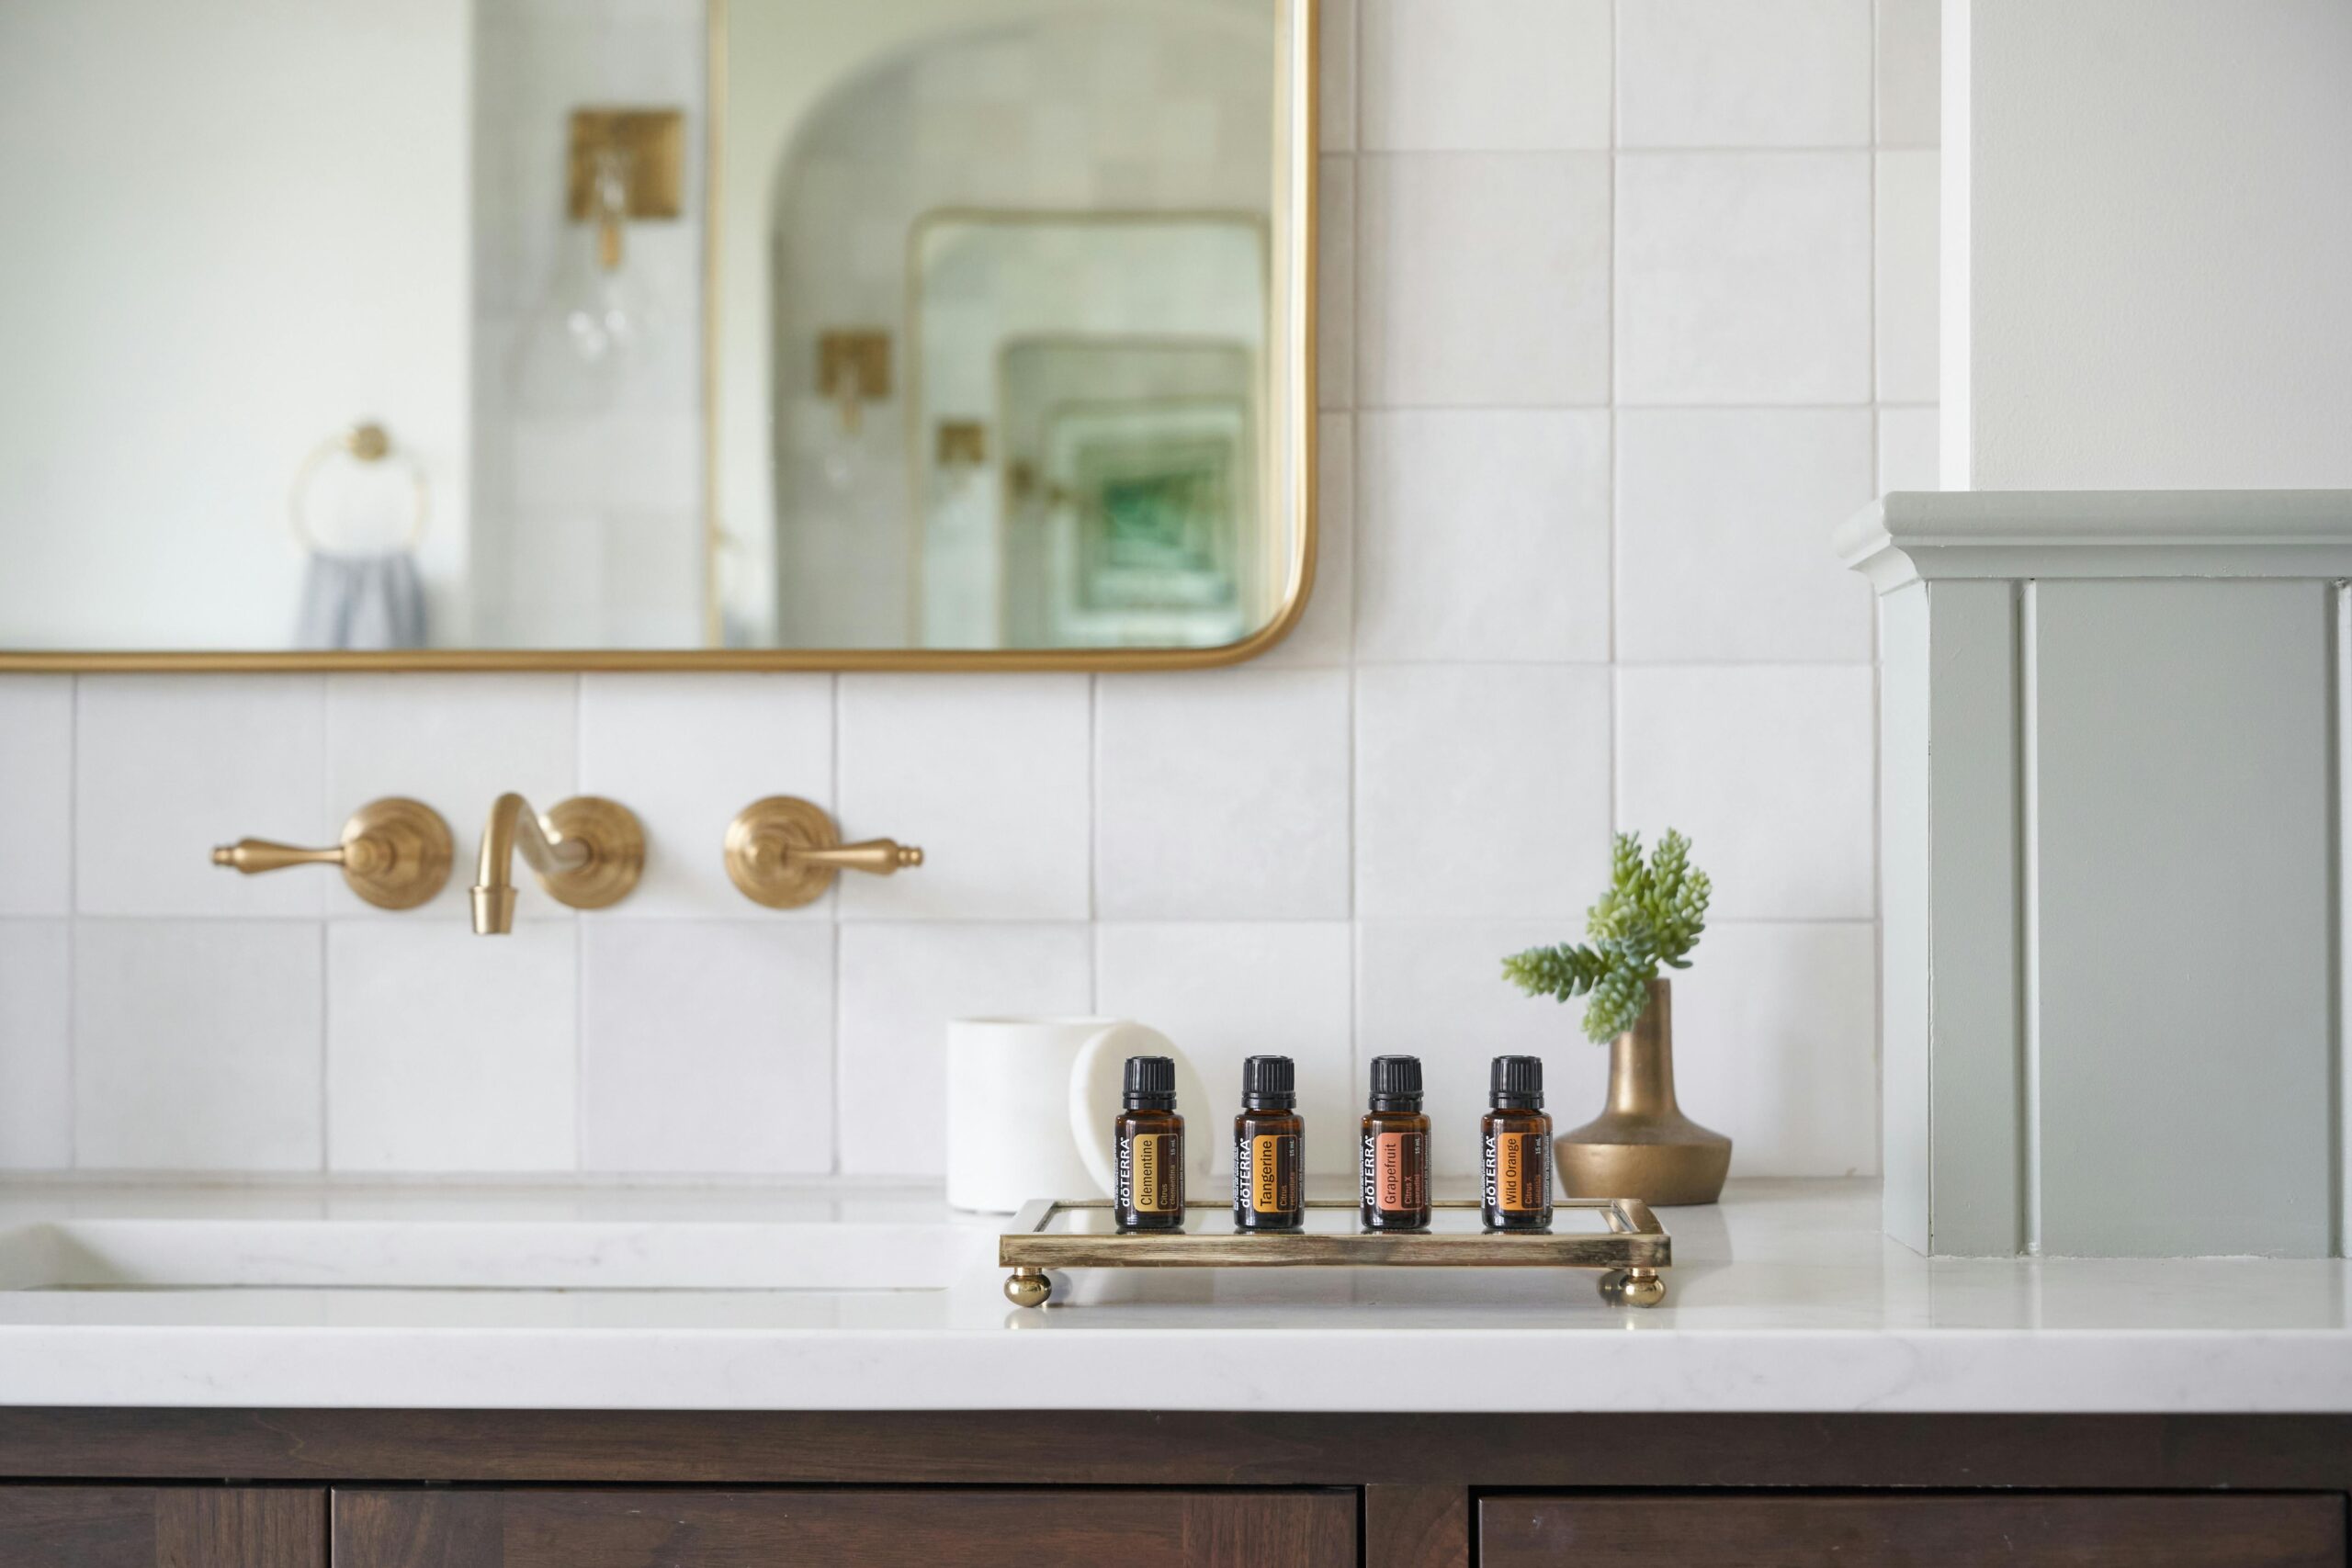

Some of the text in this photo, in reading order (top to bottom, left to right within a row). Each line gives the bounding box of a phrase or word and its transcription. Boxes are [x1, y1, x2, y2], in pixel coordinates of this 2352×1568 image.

[1141, 1140, 1152, 1205] Clementine
[1261, 1141, 1274, 1206] Tangerine
[1385, 1145, 1398, 1203] Grapefruit
[1506, 1139, 1519, 1204] Wild Orange
